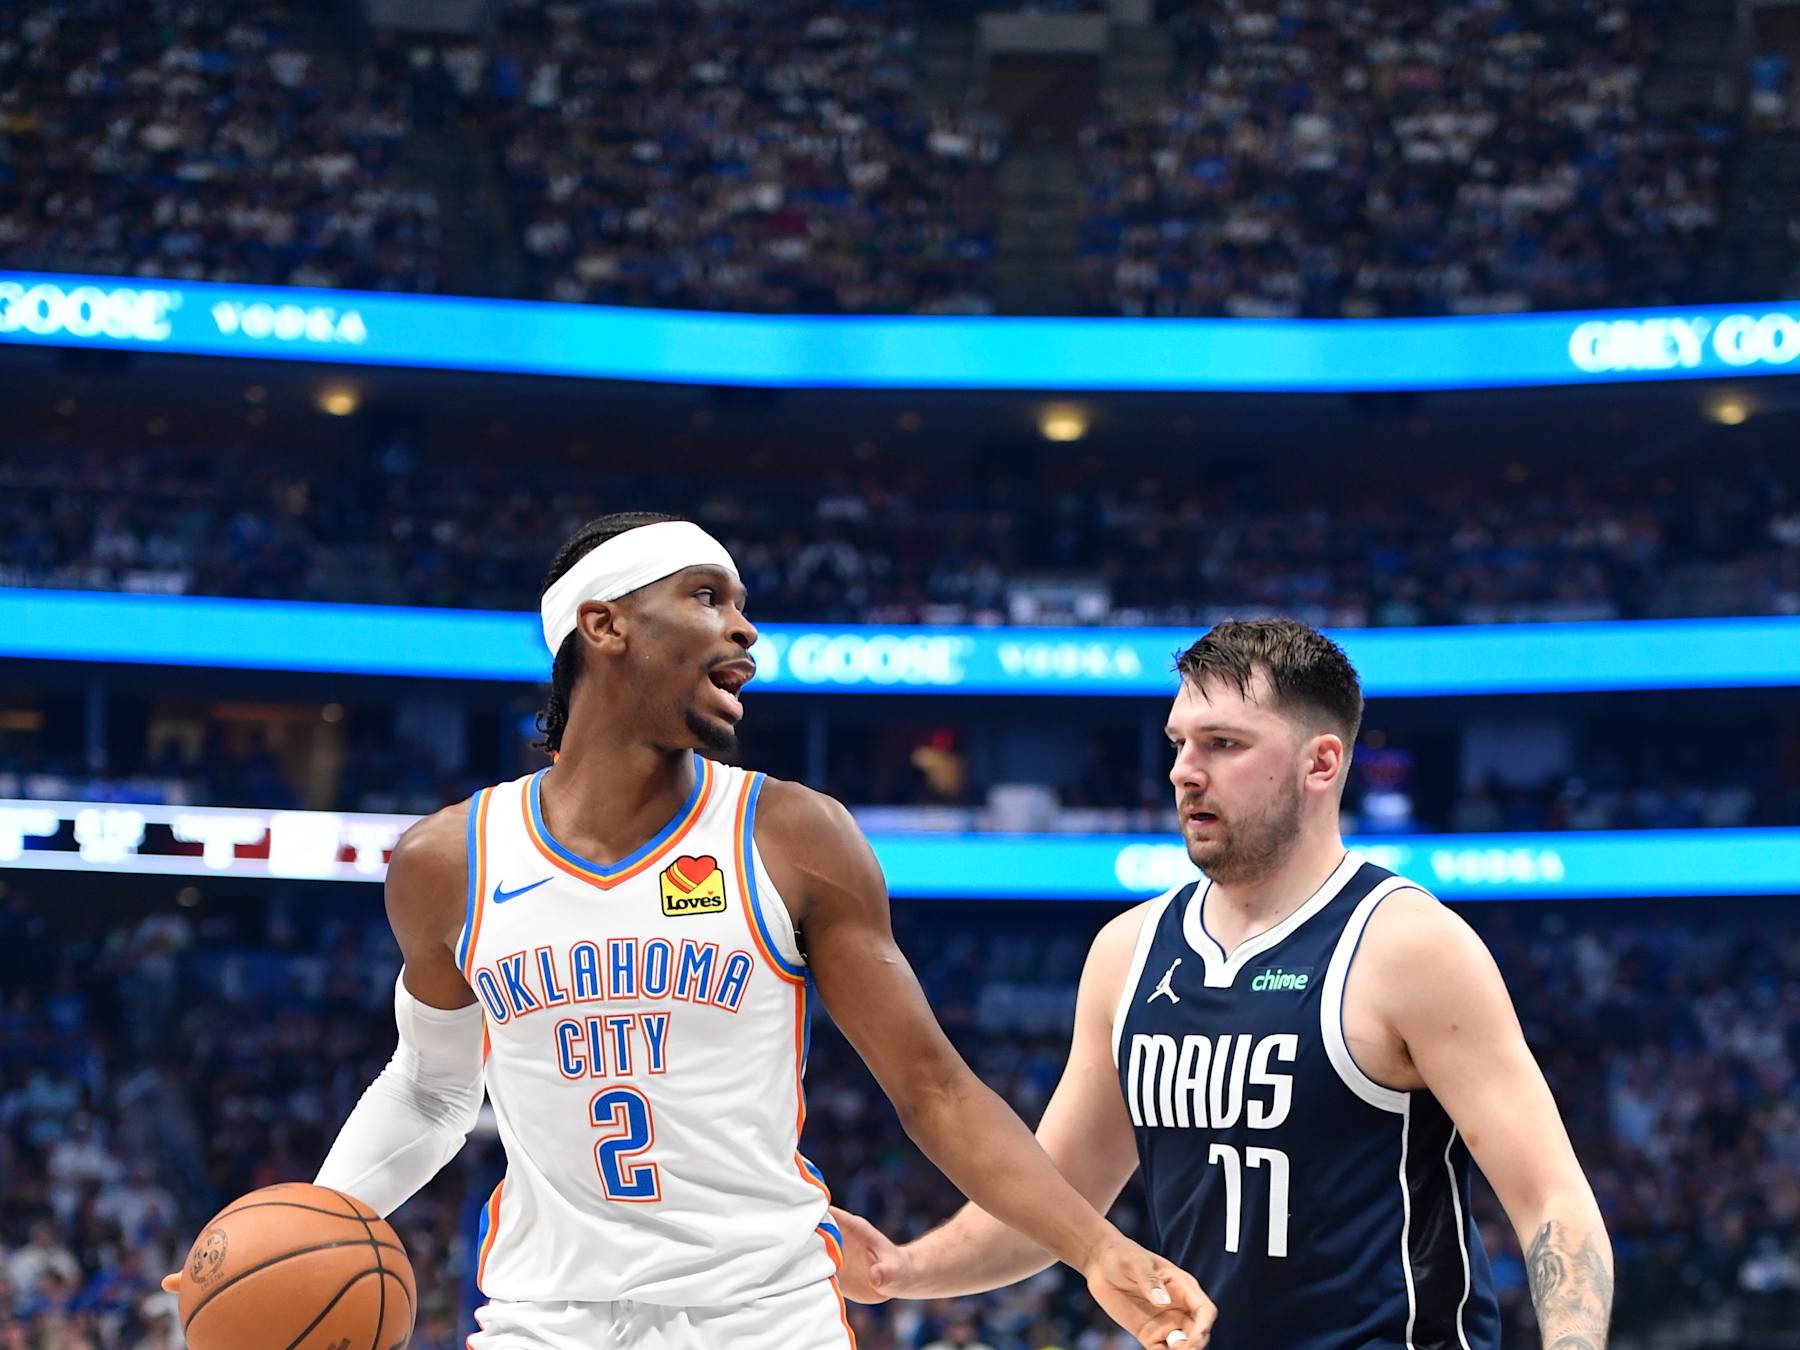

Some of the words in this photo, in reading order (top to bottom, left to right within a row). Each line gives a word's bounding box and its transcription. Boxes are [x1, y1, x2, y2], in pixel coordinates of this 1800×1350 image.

[788, 634, 966, 684] GOOSE
[475, 937, 755, 1025] OKLAHOMA
[1251, 969, 1309, 991] chime
[554, 1012, 671, 1080] CITY
[1127, 1034, 1299, 1129] MAVS
[589, 1085, 662, 1202] 2
[1208, 1143, 1290, 1258] 77
